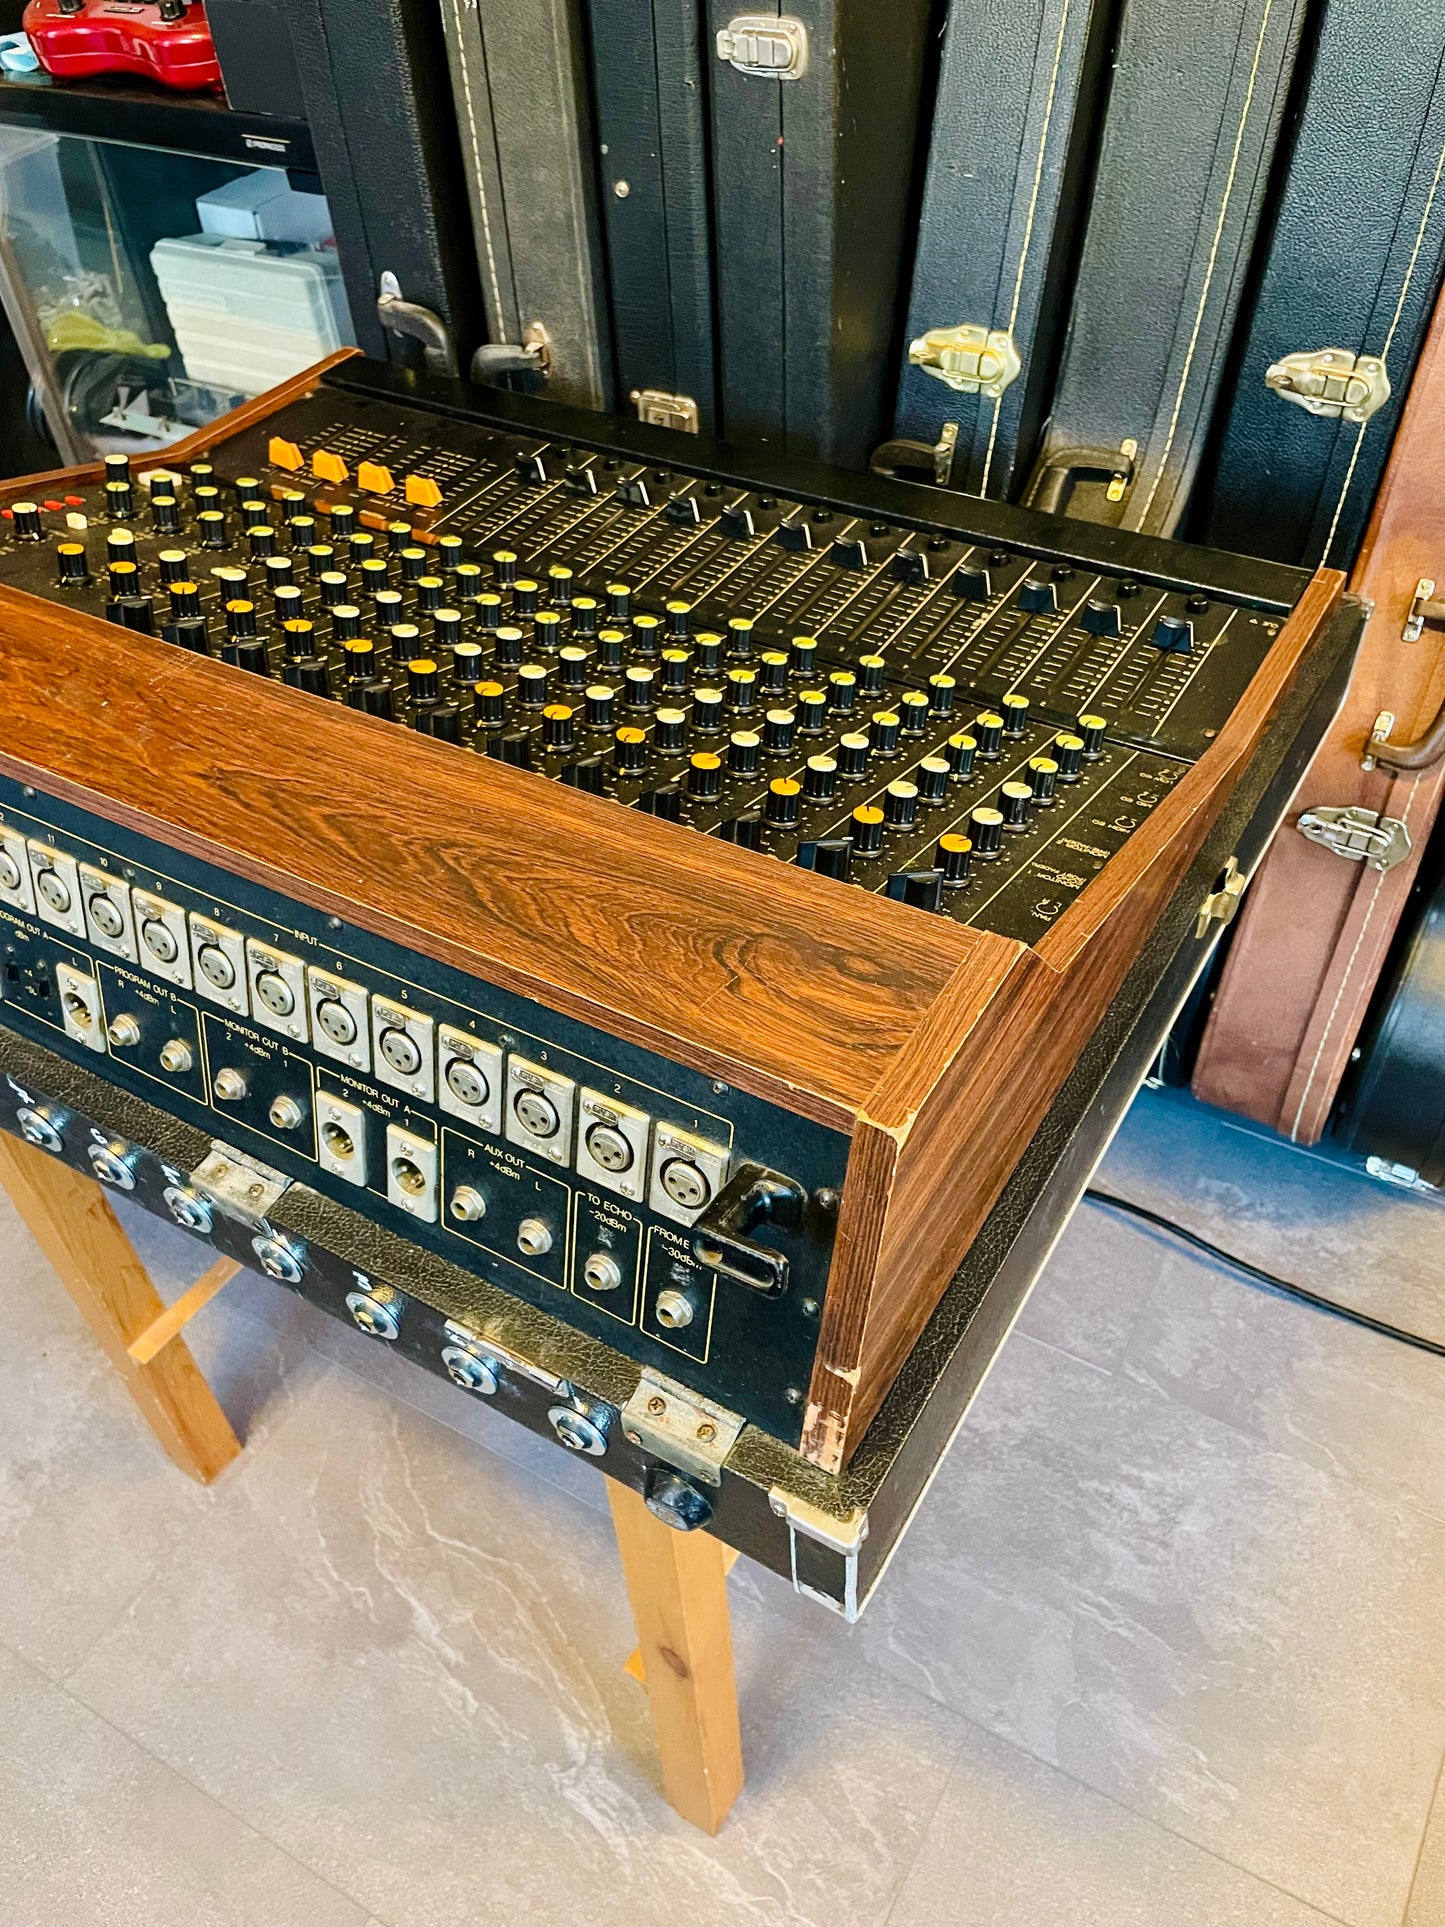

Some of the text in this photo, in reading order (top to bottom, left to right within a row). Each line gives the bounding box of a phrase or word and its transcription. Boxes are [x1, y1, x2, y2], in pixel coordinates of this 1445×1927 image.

[47, 834, 55, 843] 11
[100, 857, 108, 867] 10
[156, 882, 162, 890] 9
[214, 908, 220, 916] 8
[27, 923, 41, 936] OUT
[43, 931, 49, 939] A
[273, 933, 280, 942] 7
[294, 930, 319, 946] INPUT
[336, 961, 343, 970] 6
[115, 966, 176, 1002] PROGRAM OUT B
[118, 980, 125, 989] R
[401, 990, 408, 999] 5
[171, 1005, 177, 1014] L
[469, 1021, 476, 1029] 4
[224, 1019, 289, 1055] MONITOR OUT B
[226, 1033, 232, 1041] 2
[244, 1042, 271, 1060] +4dBm
[541, 1051, 548, 1060] 3
[343, 1089, 349, 1098] 2
[614, 1084, 621, 1094] 2
[340, 1074, 411, 1114] MONITOR OUT A
[362, 1100, 391, 1118] +4dBm
[404, 1119, 409, 1127] 1
[694, 1120, 698, 1128] 1
[467, 1149, 475, 1158] R
[484, 1144, 525, 1168] AUX OUT
[489, 1161, 520, 1180] +4dBm
[535, 1181, 542, 1192] L
[587, 1192, 633, 1221] TO ECHO
[588, 1208, 627, 1233] -20dBm
[654, 1225, 683, 1246] FROM
